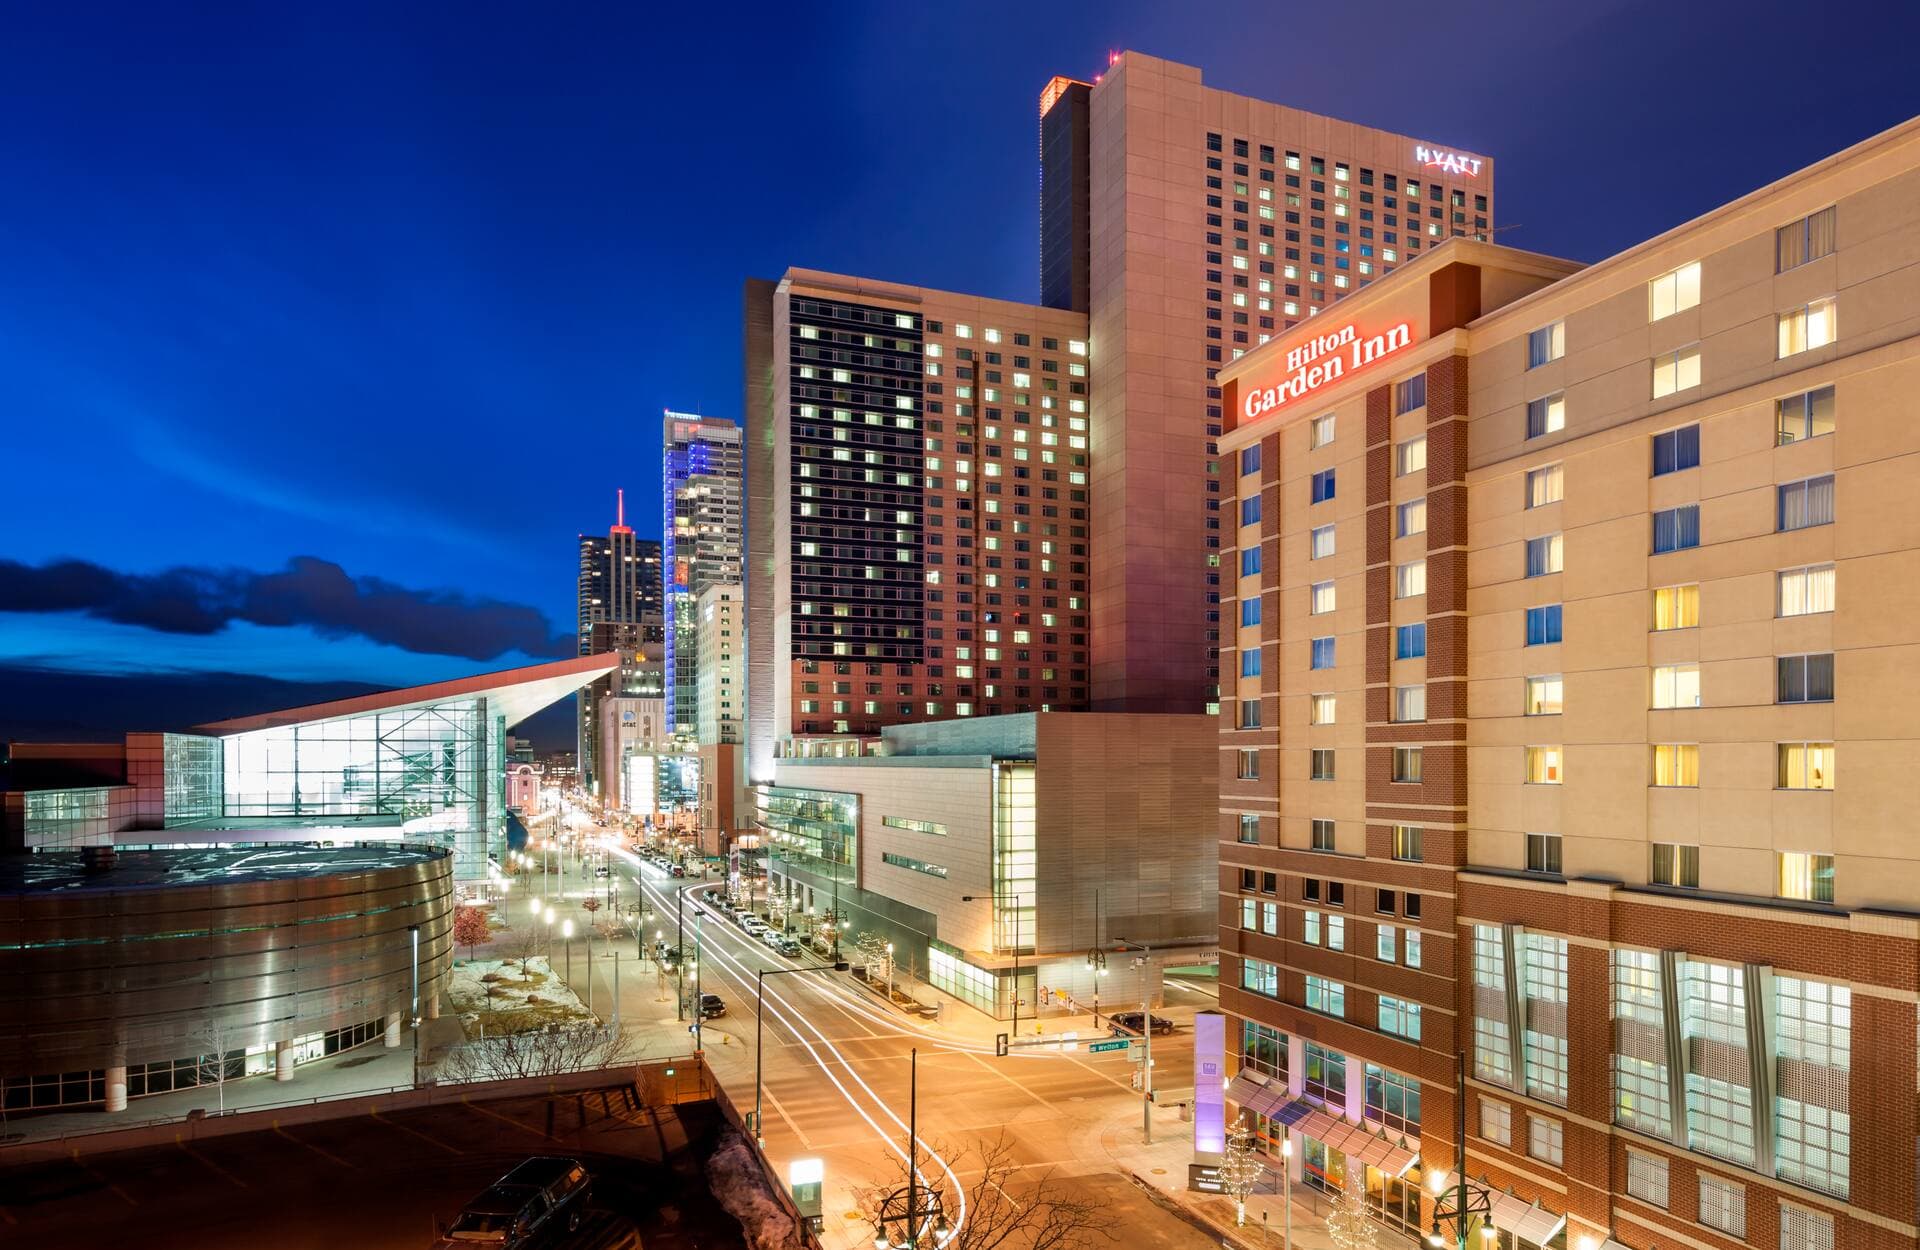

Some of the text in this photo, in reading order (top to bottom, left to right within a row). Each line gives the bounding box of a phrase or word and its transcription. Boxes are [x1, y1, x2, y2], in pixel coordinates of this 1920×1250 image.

[1416, 146, 1481, 174] HYATT
[1244, 323, 1411, 418] Garden Inn
[1285, 324, 1356, 374] Hilton
